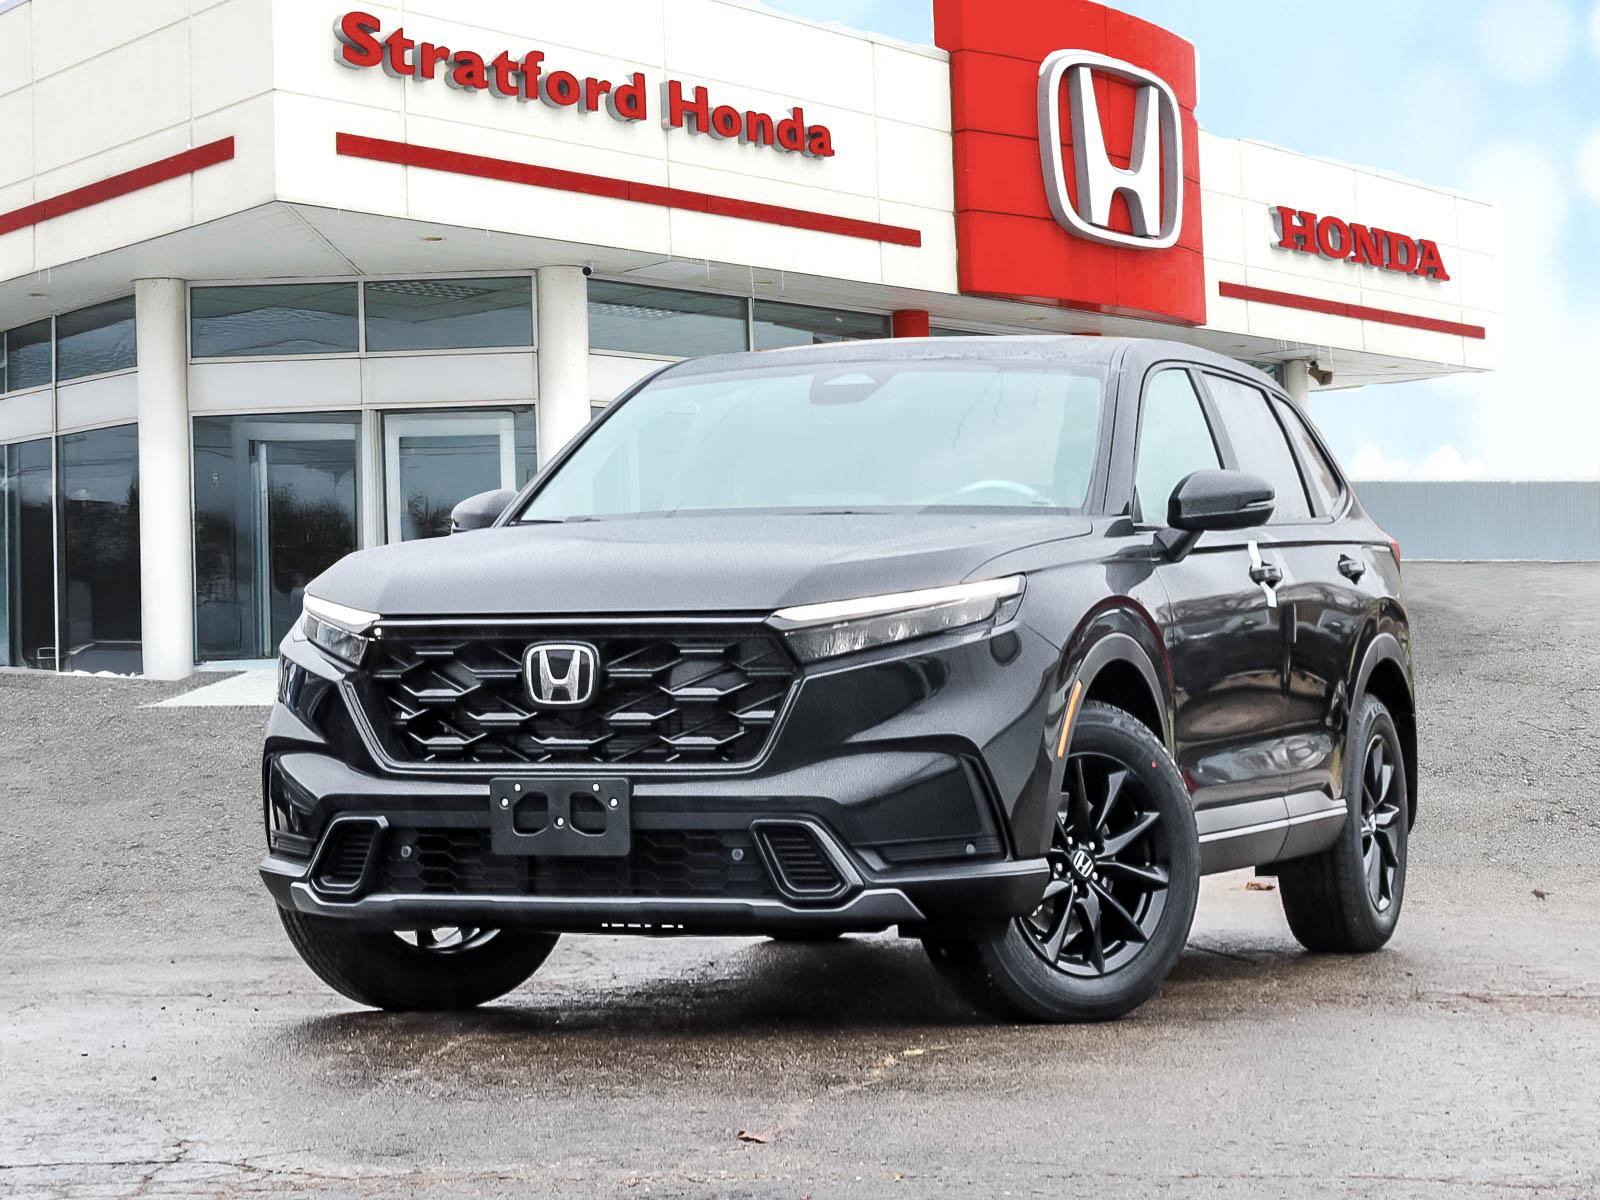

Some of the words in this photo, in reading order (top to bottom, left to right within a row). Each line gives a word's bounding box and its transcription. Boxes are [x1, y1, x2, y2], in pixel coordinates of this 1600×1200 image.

[340, 11, 647, 121] Stratford
[668, 79, 835, 157] Honda
[1277, 205, 1451, 281] HONDA
